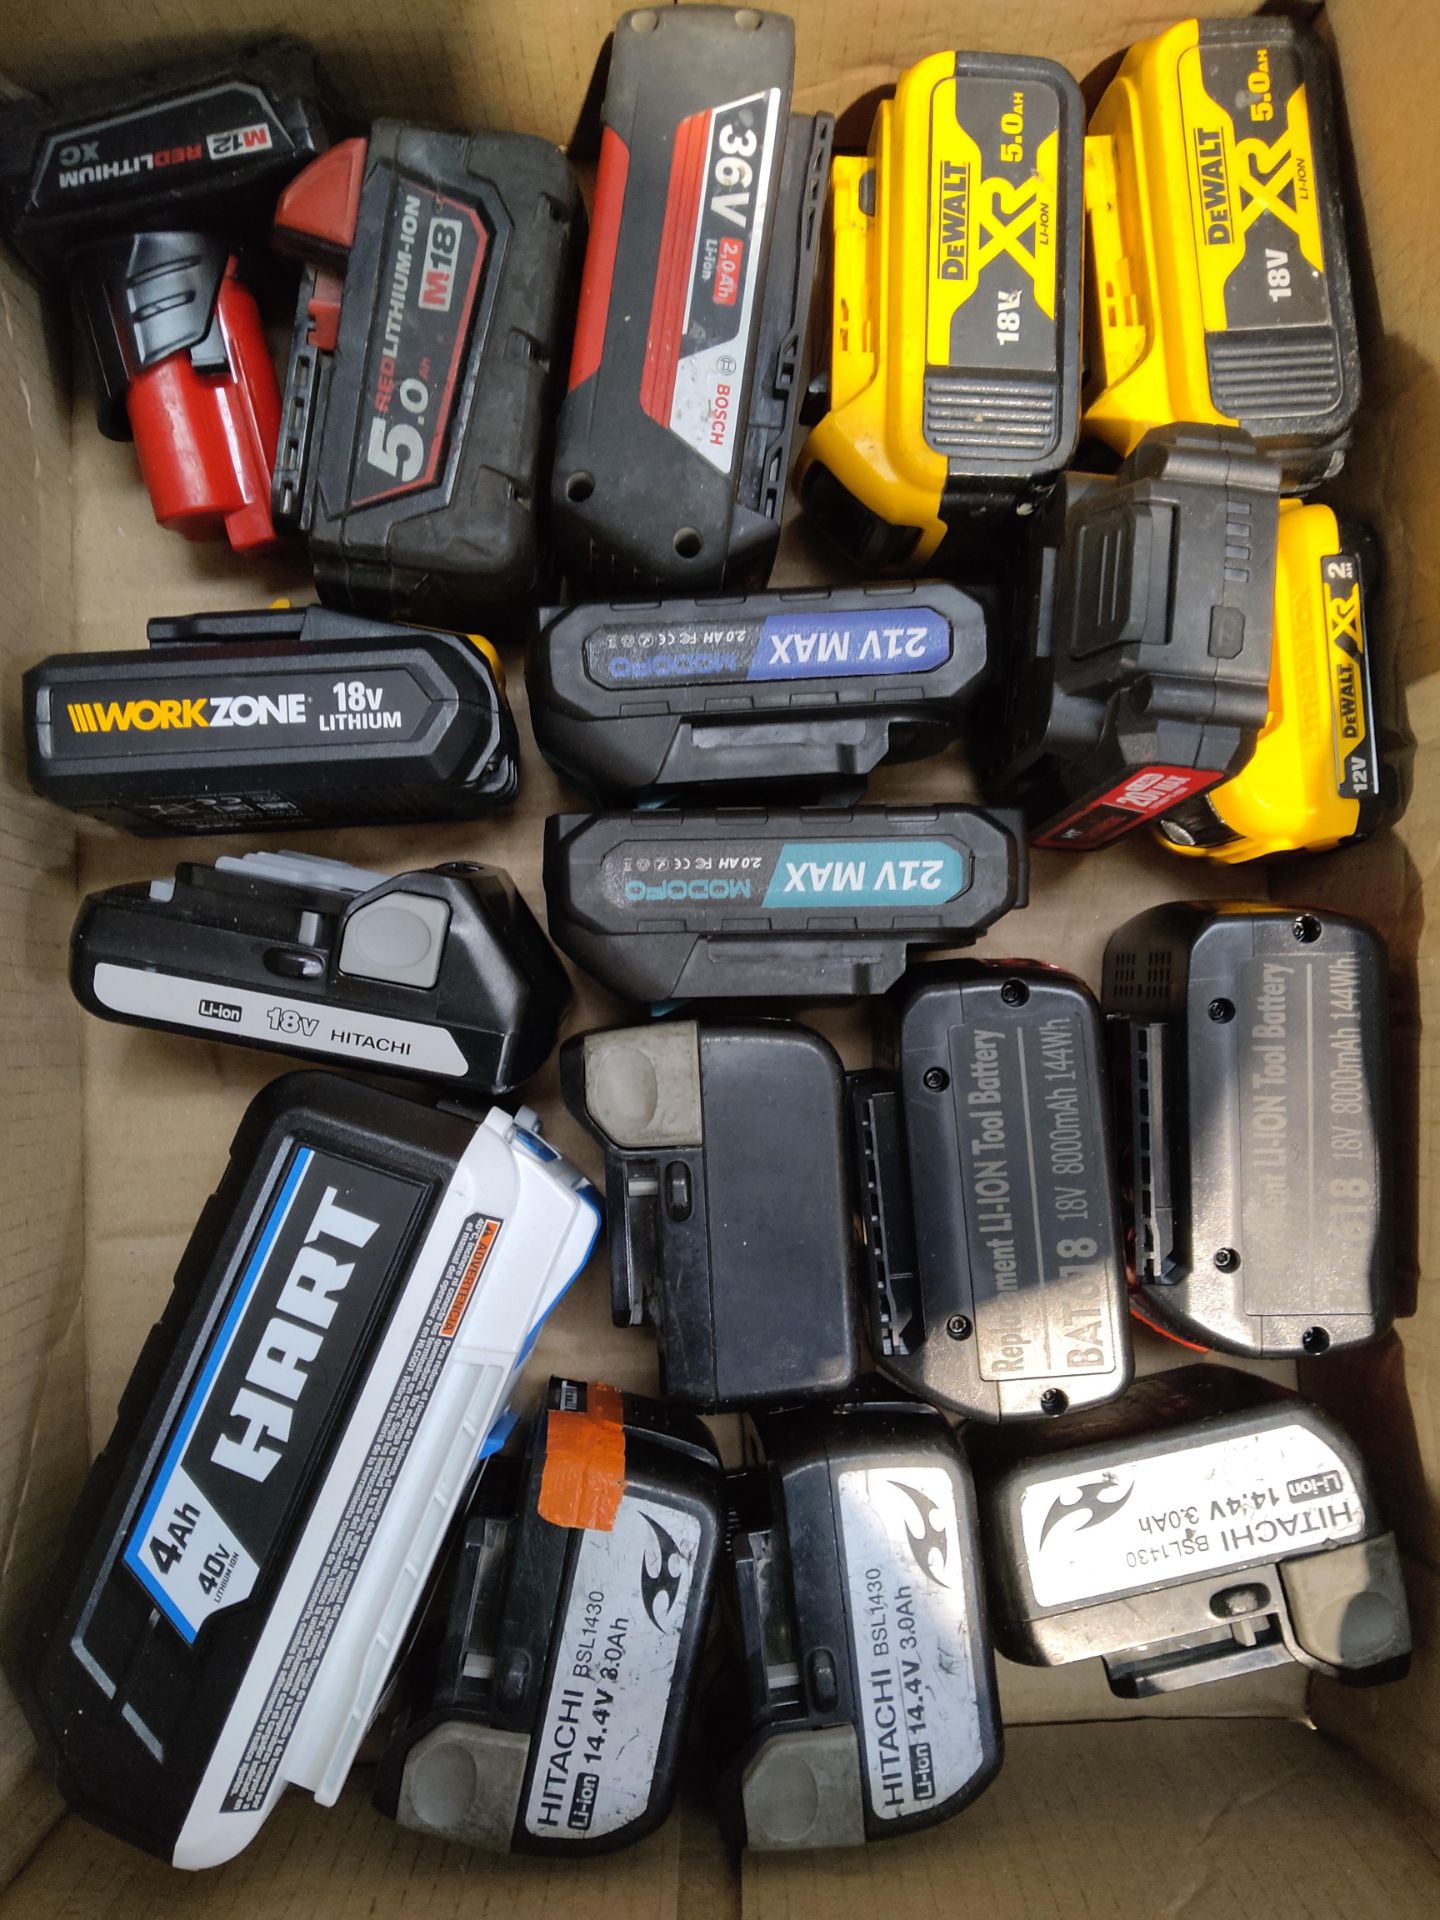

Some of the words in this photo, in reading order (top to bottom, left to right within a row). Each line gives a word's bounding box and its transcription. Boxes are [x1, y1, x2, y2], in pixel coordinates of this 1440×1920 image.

[59, 142, 99, 166] XC
[213, 128, 267, 154] M12
[60, 145, 201, 188] REDLITHIUM
[711, 124, 757, 229] 36V
[1235, 138, 1298, 235] XR
[1297, 158, 1309, 200] LI-ION
[978, 176, 1038, 278] XR
[1040, 202, 1049, 245] LI-ION
[423, 223, 457, 304] M18
[1265, 248, 1292, 302] 18V
[374, 195, 420, 414] REDLITHIUM-ION
[997, 290, 1022, 346] 18V
[711, 383, 730, 446] BOSCH
[769, 631, 850, 664] MAX
[859, 627, 927, 660] 21V
[93, 694, 305, 731] WORKZONE
[319, 712, 401, 730] LITHIUM
[1351, 756, 1367, 793] 12V
[719, 857, 739, 869] AH
[742, 857, 762, 868] 2.0
[784, 862, 866, 892] MAX
[873, 860, 944, 891] 21V
[624, 878, 751, 900] MODOFO
[1253, 962, 1295, 1039] Battery
[1329, 958, 1361, 1020] 144Wh
[200, 1001, 240, 1021] Li-ion
[331, 1030, 410, 1055] HITACHI
[1039, 1017, 1076, 1080] 144Wh
[968, 1029, 1005, 1105] Battery
[1252, 1046, 1286, 1088] Tool
[1329, 1028, 1362, 1115] 8000mAh
[969, 1111, 1005, 1156] Tool
[1047, 1087, 1084, 1174] 8000mAh
[1252, 1095, 1287, 1167] LI-ION
[1331, 1125, 1363, 1160] 18V
[973, 1160, 1014, 1233] LI-ION
[1055, 1187, 1088, 1220] 18V
[451, 1231, 470, 1264] manual
[465, 1222, 474, 1231] el
[445, 1264, 456, 1279] del
[454, 1241, 474, 1277] incinere
[426, 1278, 450, 1319] operador
[442, 1241, 489, 1333] ADVERTENCIA
[450, 1276, 459, 1286] ni
[211, 1186, 380, 1483] HART
[420, 1325, 430, 1338] en
[436, 1338, 451, 1360] Para
[1210, 1488, 1279, 1521] 14.4V
[1288, 1475, 1341, 1496] Li-ion
[149, 1503, 201, 1575] 4Ah
[1138, 1506, 1199, 1534] 3.0Ah
[1221, 1502, 1353, 1551] HITACHI
[1126, 1535, 1210, 1567] BSL1430
[214, 1569, 232, 1603] LITHIUM
[866, 1568, 889, 1656] BSL1430
[895, 1586, 916, 1649] 3.0Ah
[537, 1689, 584, 1826] HITACHI
[573, 1591, 604, 1678] BSL1430
[902, 1660, 926, 1734] 14.4V
[571, 1775, 597, 1828] Li-ion
[584, 1688, 613, 1763] 14.4V
[600, 1617, 628, 1679] 3.0Ah
[871, 1669, 904, 1806] HITACHI
[915, 1744, 932, 1798] Li-ion
